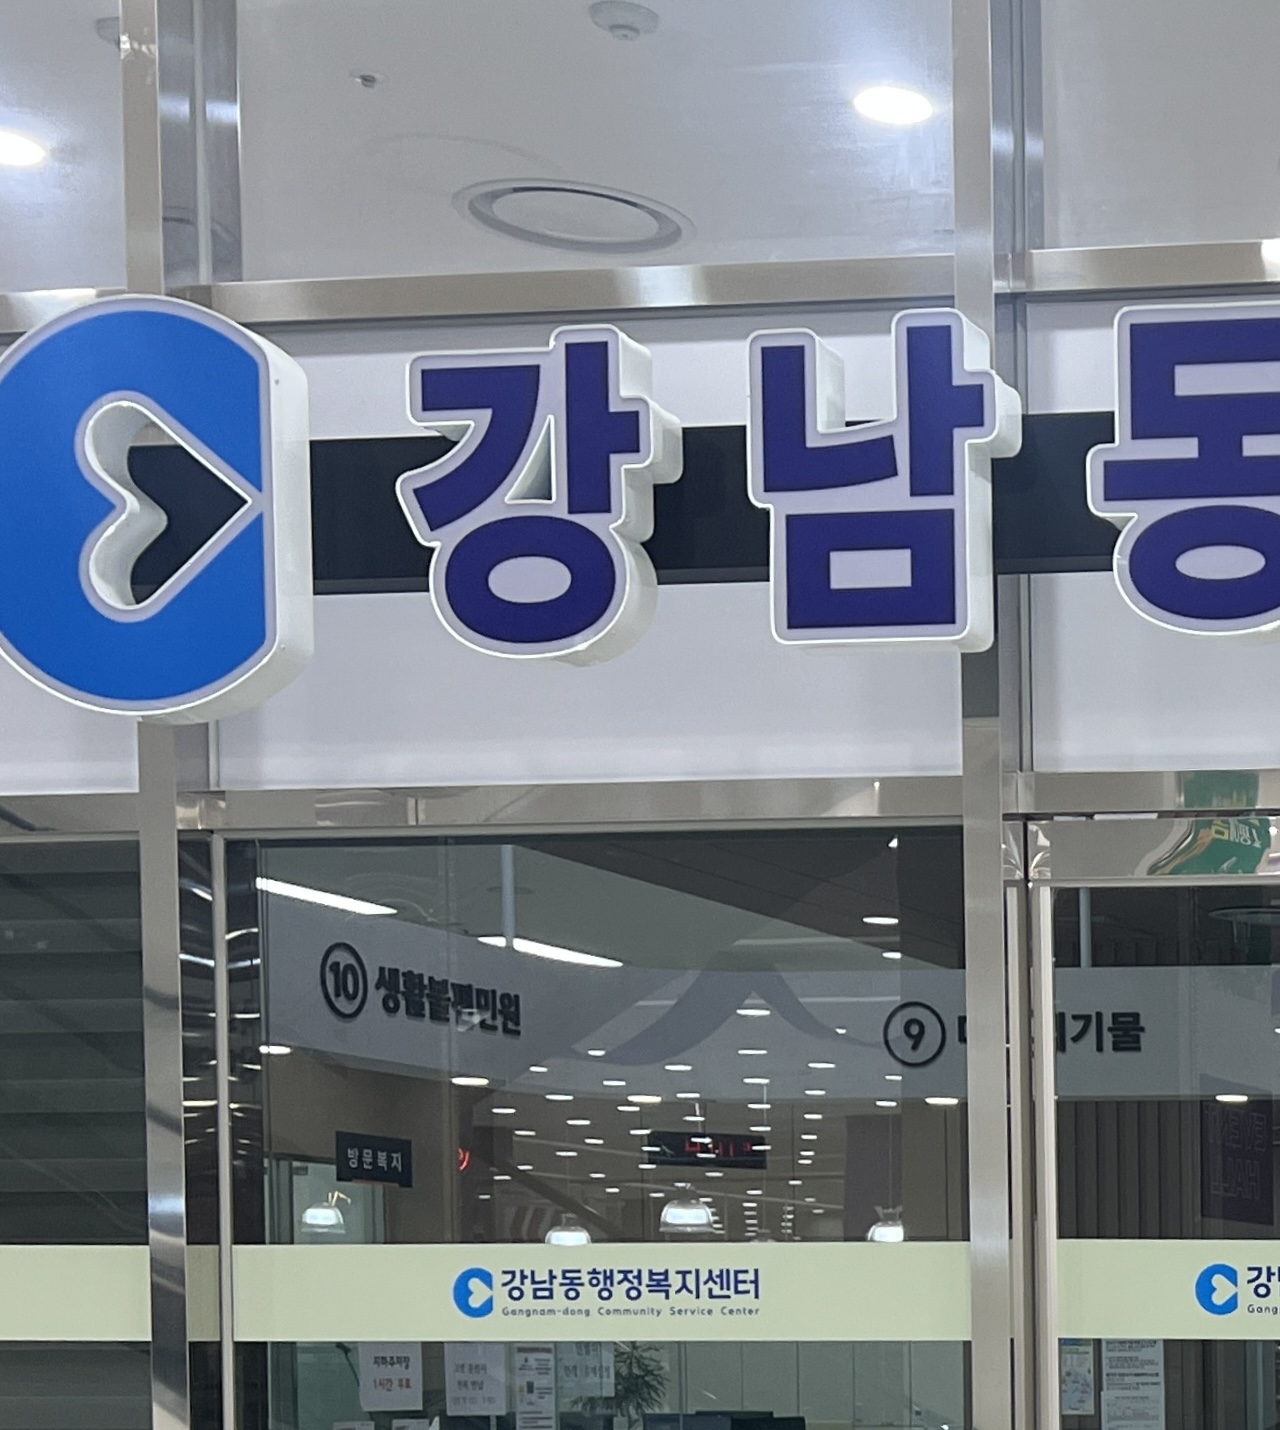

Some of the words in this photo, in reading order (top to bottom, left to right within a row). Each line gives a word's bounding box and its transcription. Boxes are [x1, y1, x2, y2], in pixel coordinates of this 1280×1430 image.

[347, 1147, 402, 1173] 방문복지
[500, 1267, 761, 1301] 강남동행정복지센터
[501, 1306, 590, 1317] Gangnam-dong
[597, 1306, 662, 1317] Community
[669, 1306, 713, 1317] Service
[720, 1306, 760, 1317] Center
